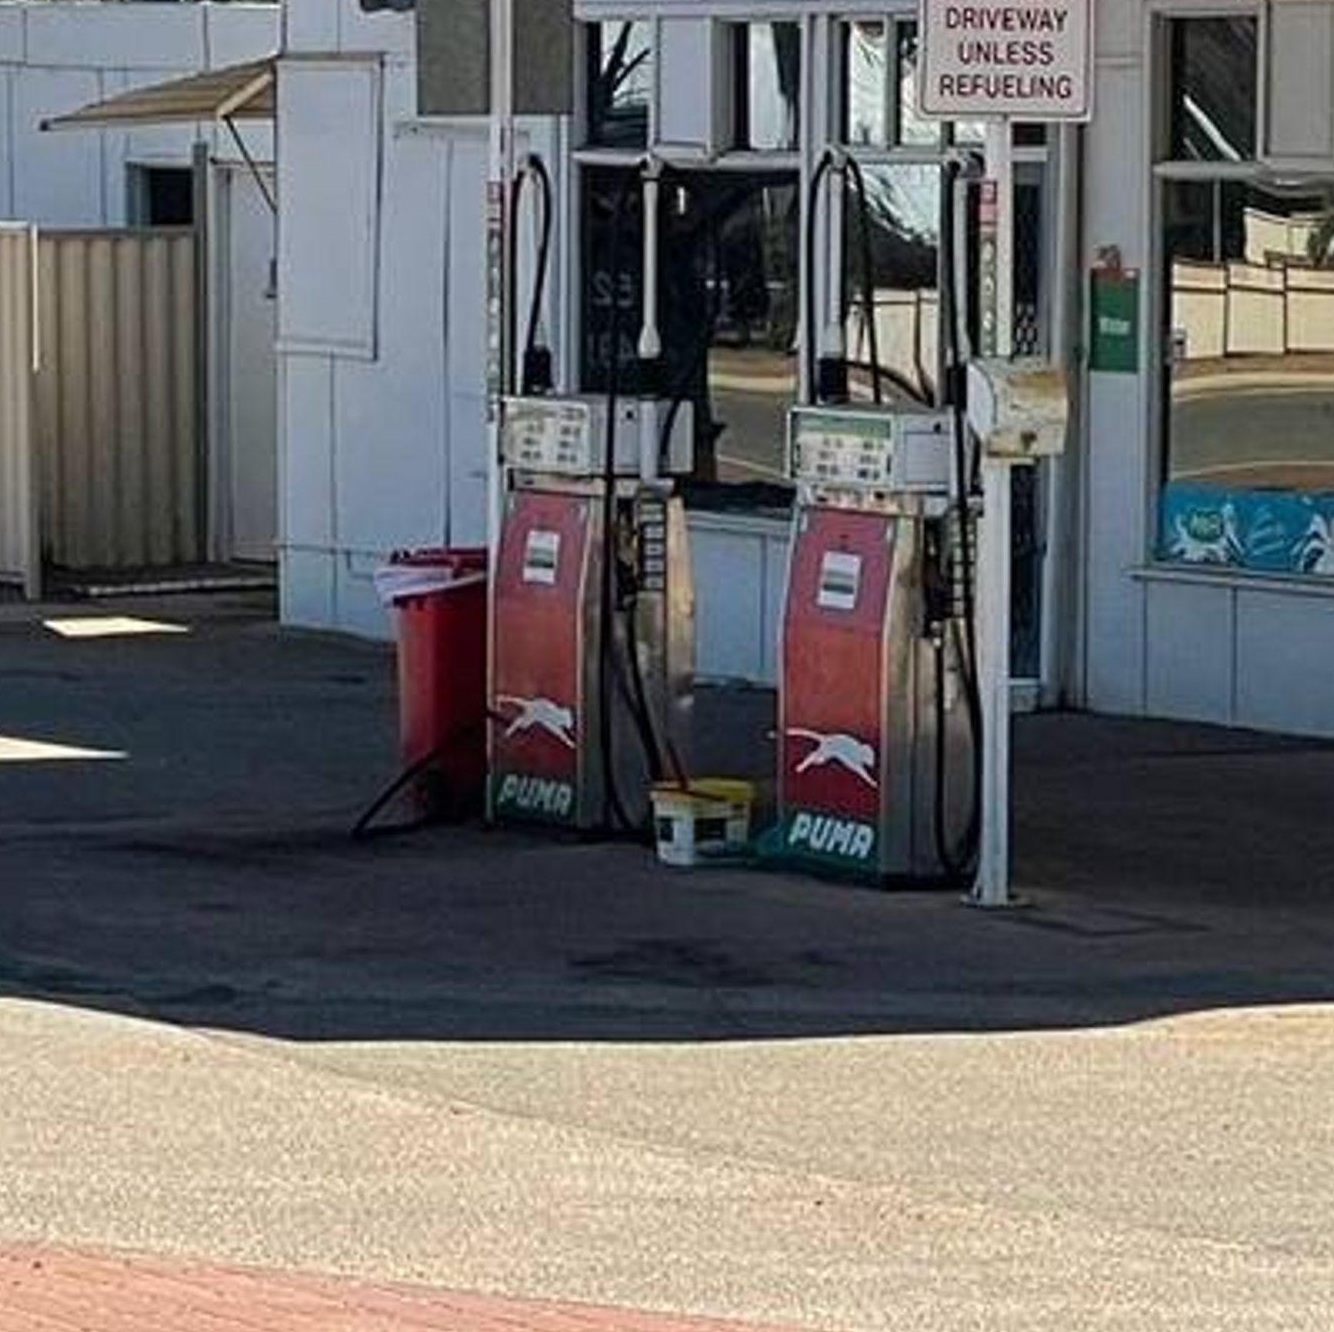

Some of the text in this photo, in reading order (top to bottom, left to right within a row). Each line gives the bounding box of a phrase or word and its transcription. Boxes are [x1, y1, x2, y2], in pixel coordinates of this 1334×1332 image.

[946, 6, 1069, 33] DRIVEWAY
[958, 40, 1055, 66] UNLESS
[939, 74, 1073, 100] REFUELING
[496, 773, 573, 817] PUMA
[788, 812, 875, 860] PUMA
